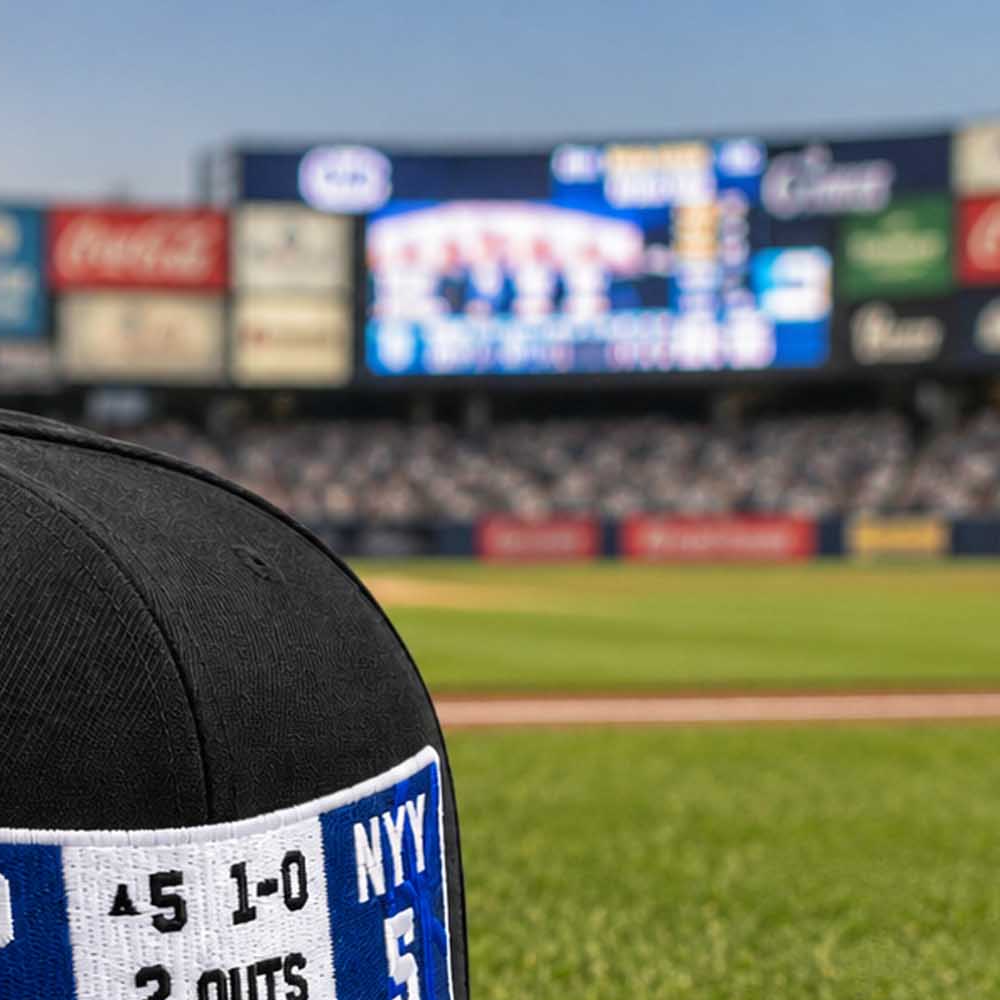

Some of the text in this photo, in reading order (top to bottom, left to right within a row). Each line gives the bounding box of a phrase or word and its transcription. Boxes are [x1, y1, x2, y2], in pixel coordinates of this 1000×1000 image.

[149, 850, 309, 933] 5 1-0
[353, 793, 426, 903] NYY
